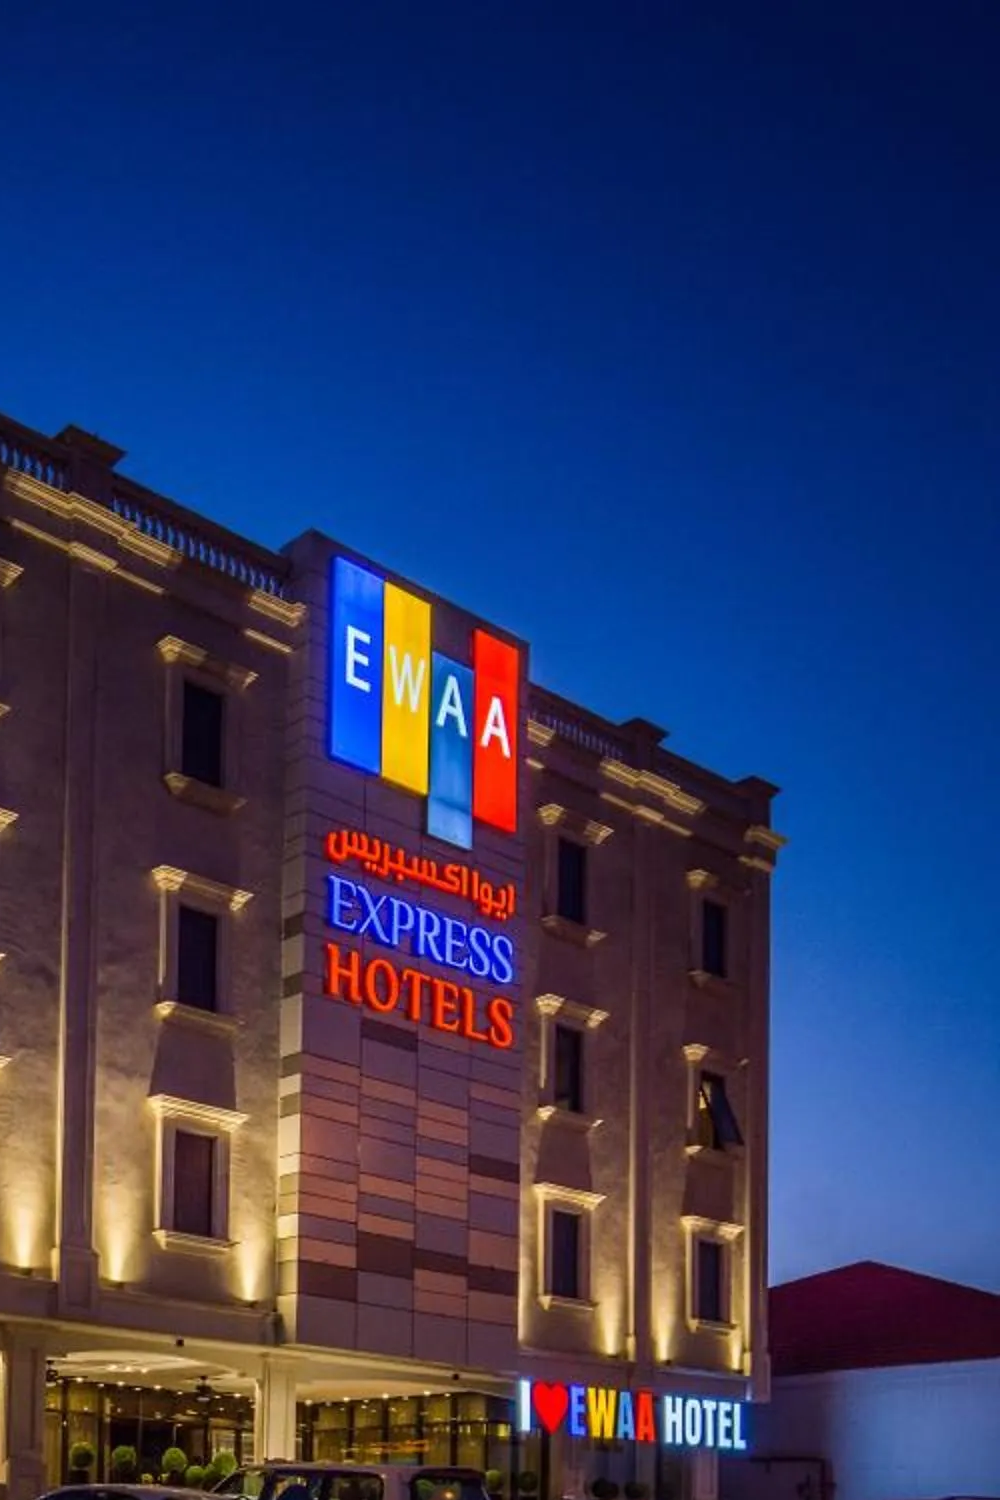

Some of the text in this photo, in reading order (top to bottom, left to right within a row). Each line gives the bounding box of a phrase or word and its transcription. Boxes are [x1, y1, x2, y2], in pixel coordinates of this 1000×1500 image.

[345, 625, 511, 759] EWAA
[328, 874, 514, 984] EXPRESS
[471, 870, 516, 920] ايوا
[326, 943, 514, 1048] HOTELS
[519, 1379, 748, 1450] I EWAA HOTEL
